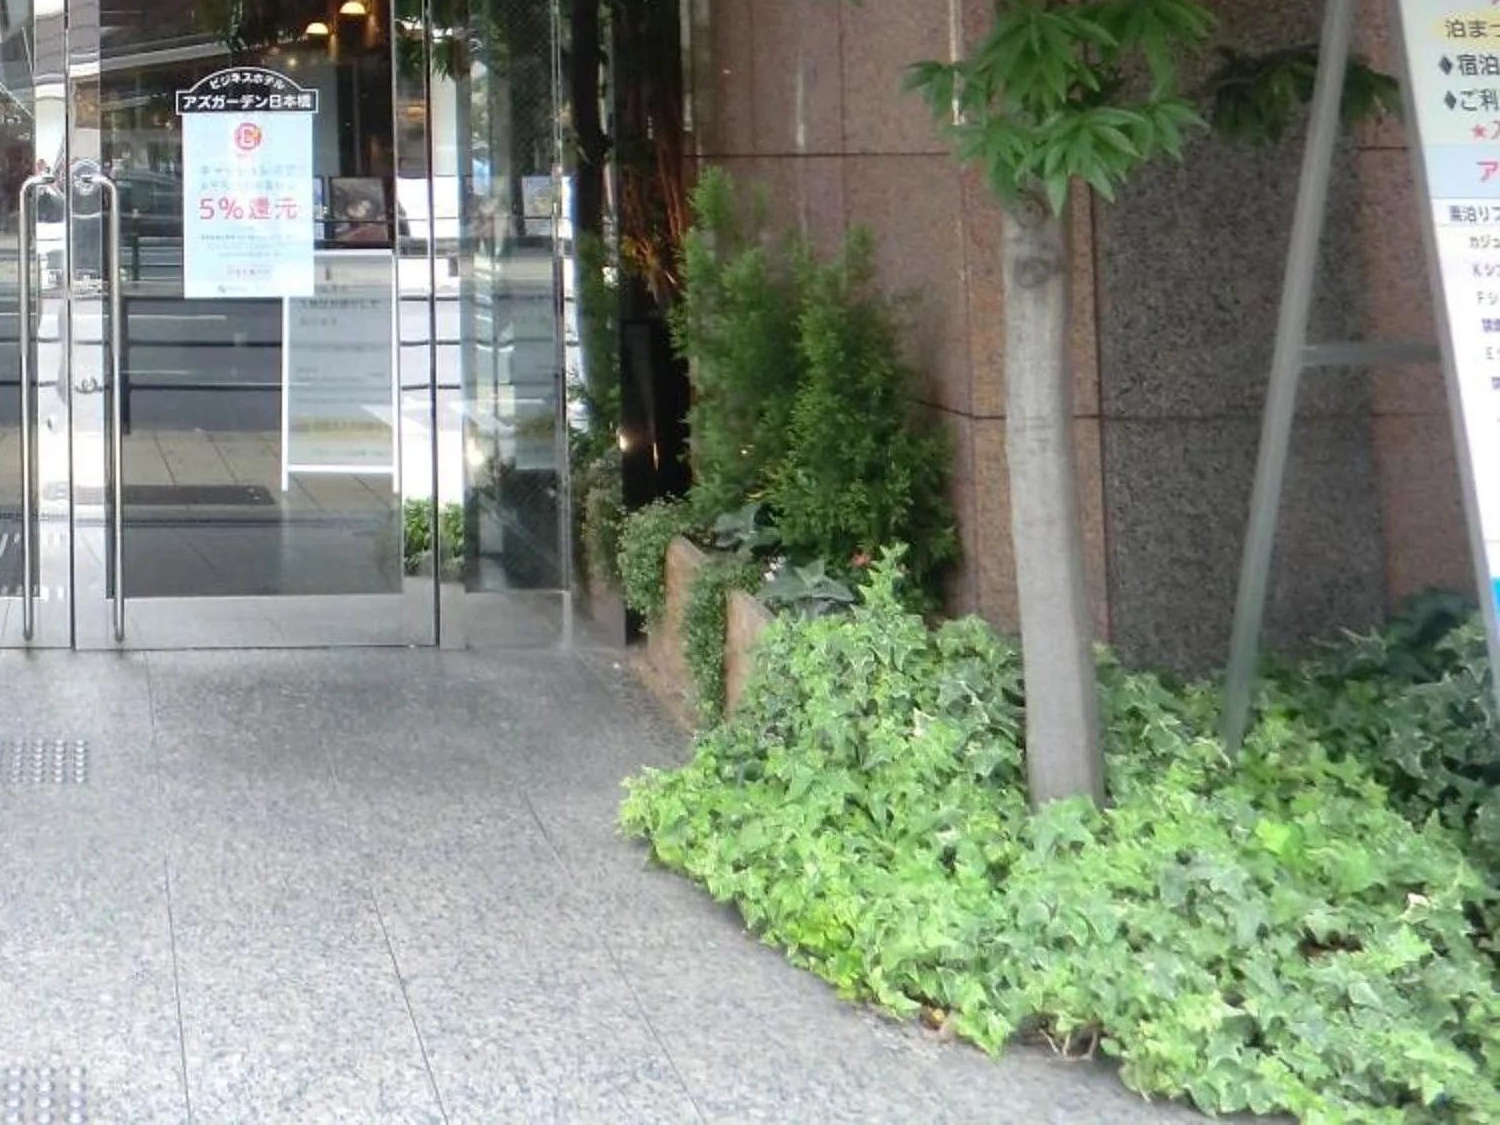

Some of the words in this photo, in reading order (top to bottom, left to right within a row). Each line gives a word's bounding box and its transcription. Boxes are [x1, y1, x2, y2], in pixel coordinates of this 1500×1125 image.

[209, 72, 285, 90] ビジネスホテル
[183, 93, 313, 110] アズガーデン日本橋
[199, 197, 299, 221] 5%還元
